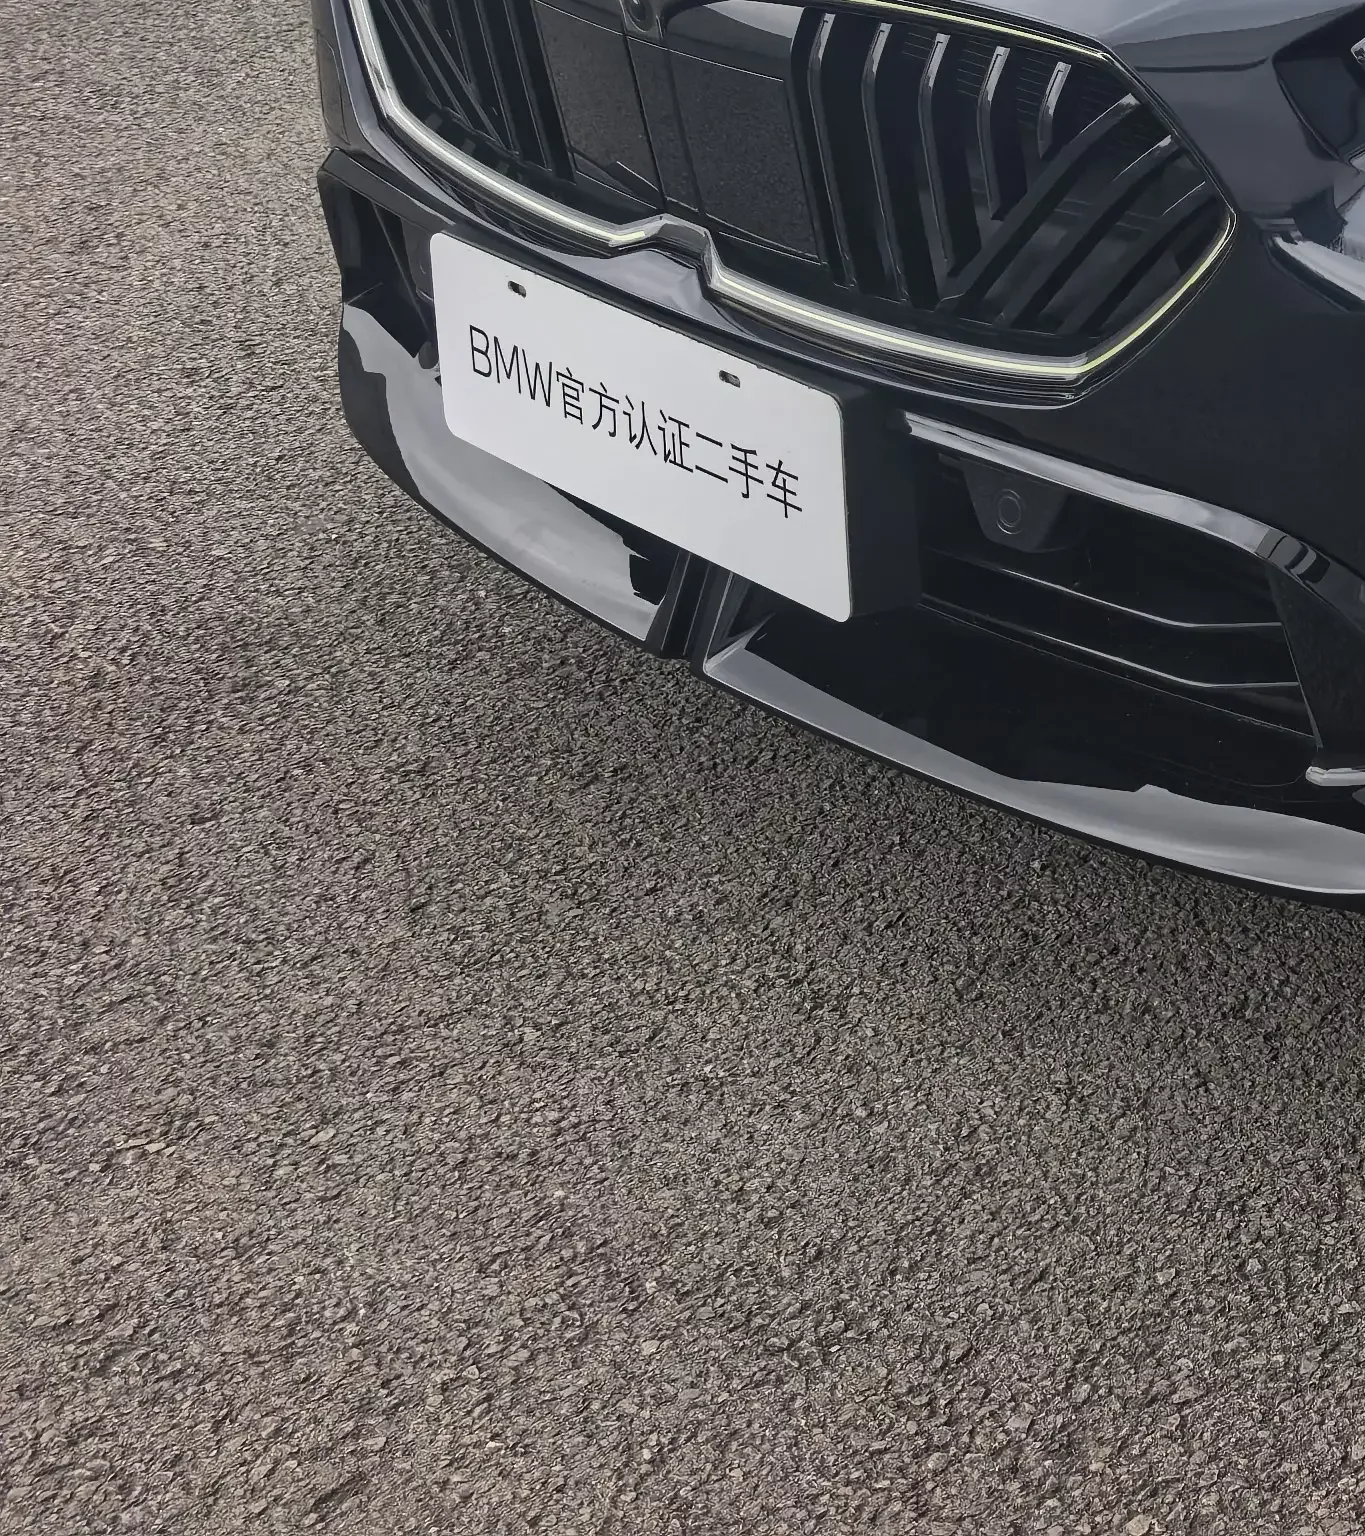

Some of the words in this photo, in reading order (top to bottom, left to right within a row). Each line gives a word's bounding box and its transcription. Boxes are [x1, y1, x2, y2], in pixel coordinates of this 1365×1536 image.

[468, 324, 803, 519] BMW官方认证二手车
